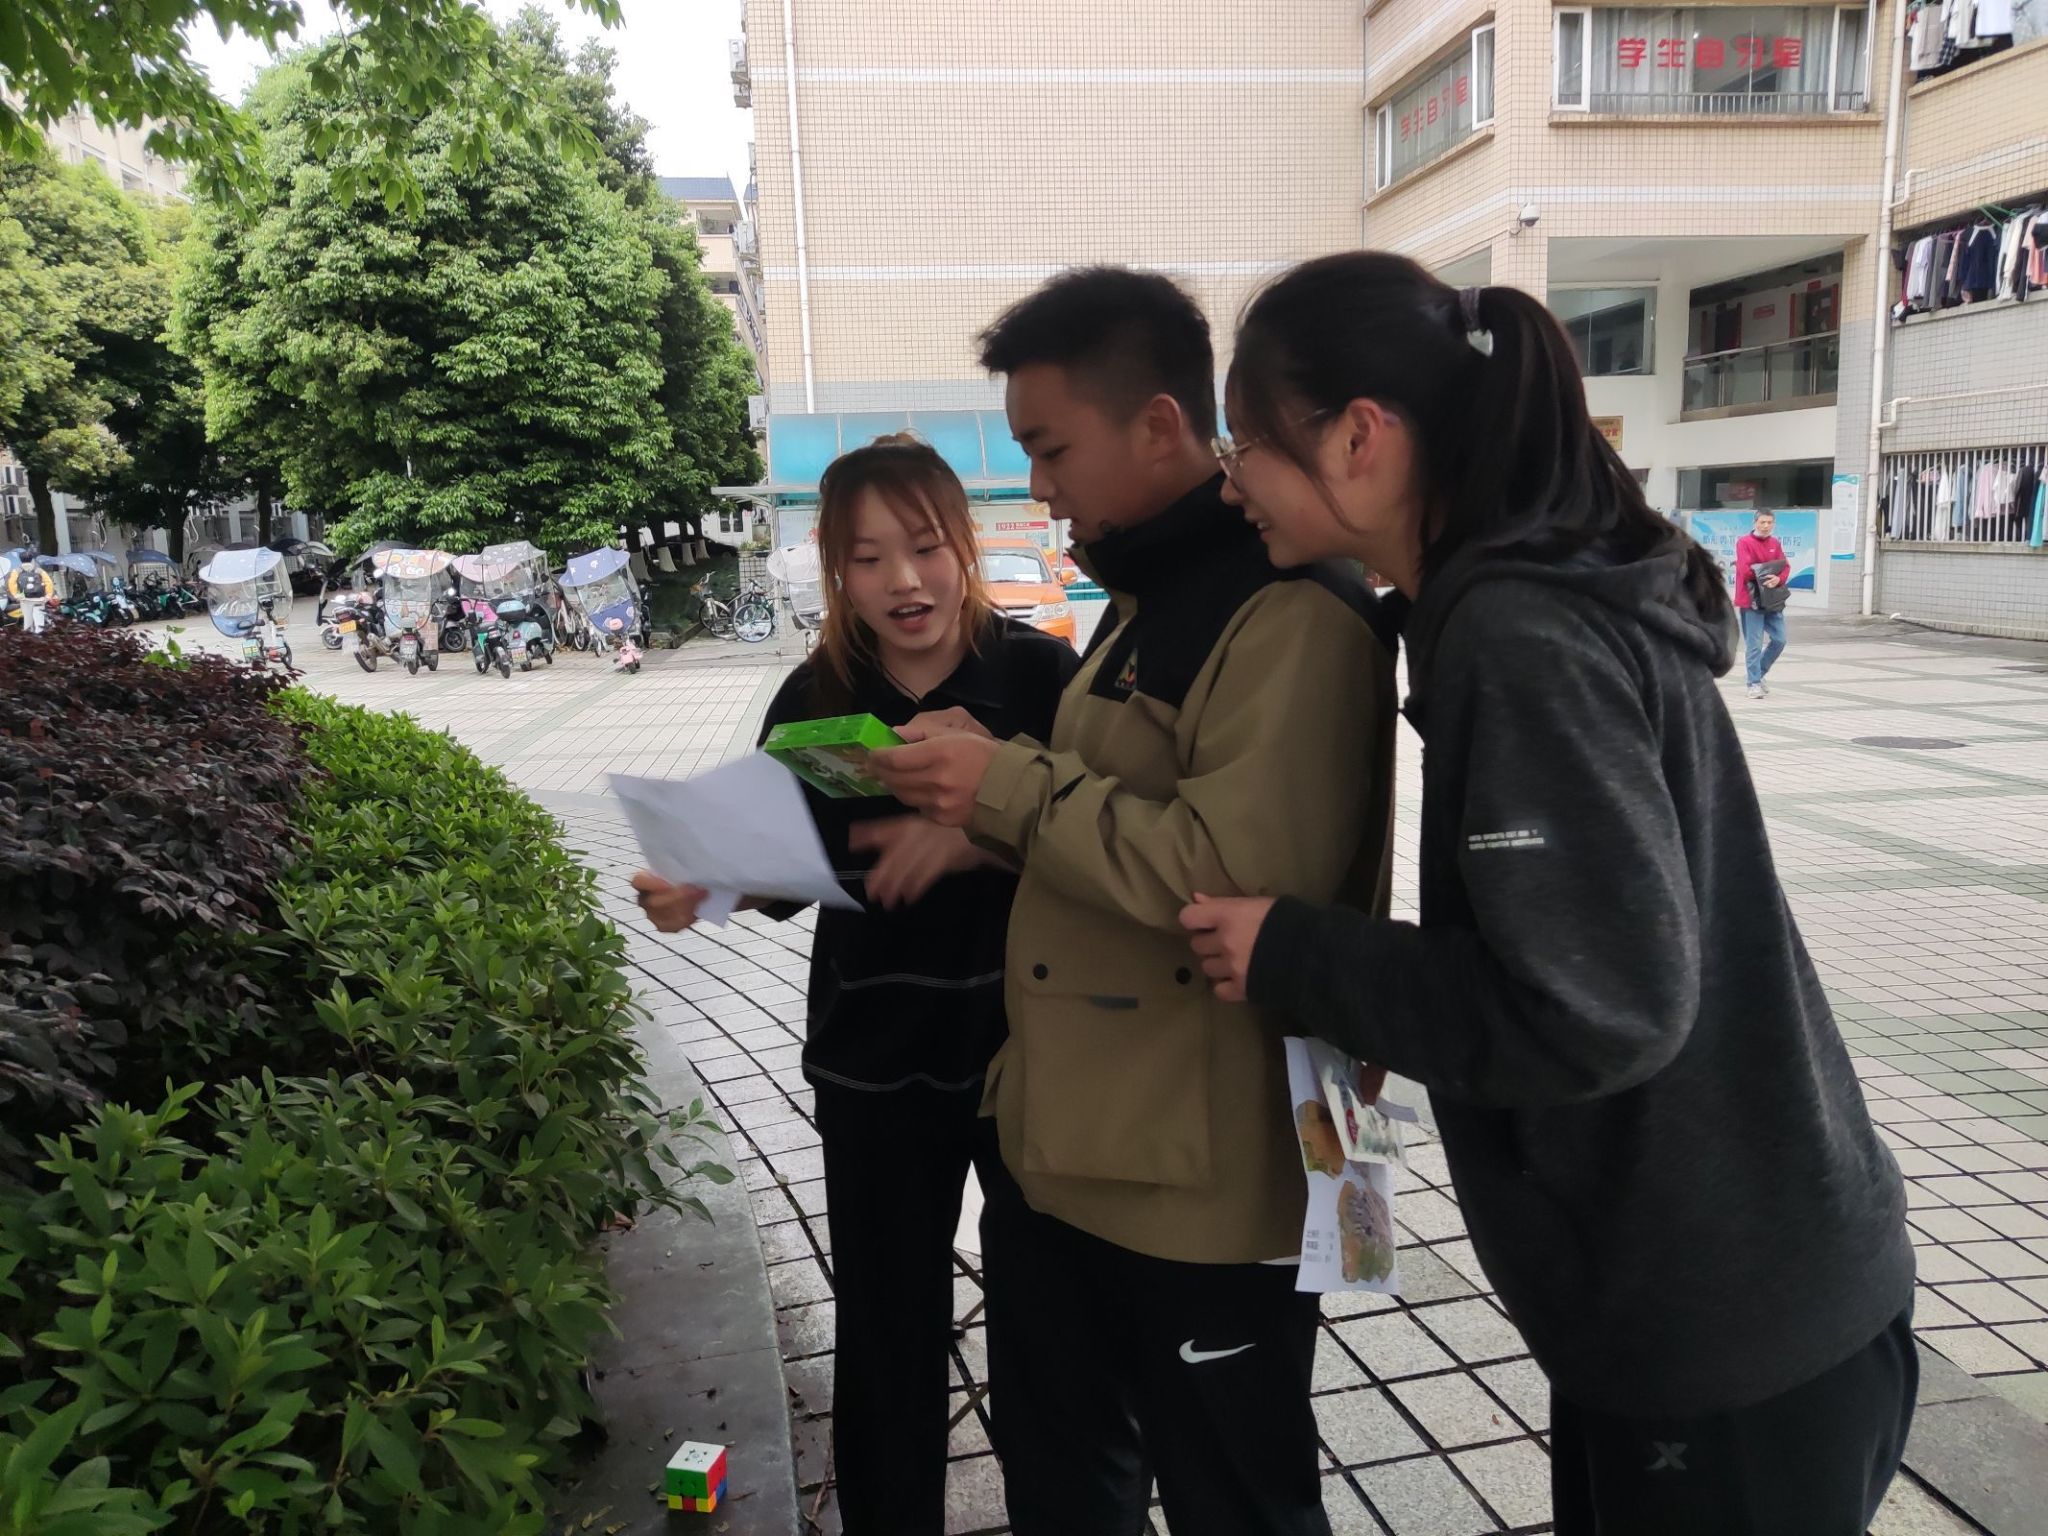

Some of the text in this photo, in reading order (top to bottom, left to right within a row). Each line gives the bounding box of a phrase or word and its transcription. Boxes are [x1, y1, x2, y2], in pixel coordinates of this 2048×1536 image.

[1617, 37, 1803, 69] 学生自习室
[1400, 76, 1468, 143] 学生自习室
